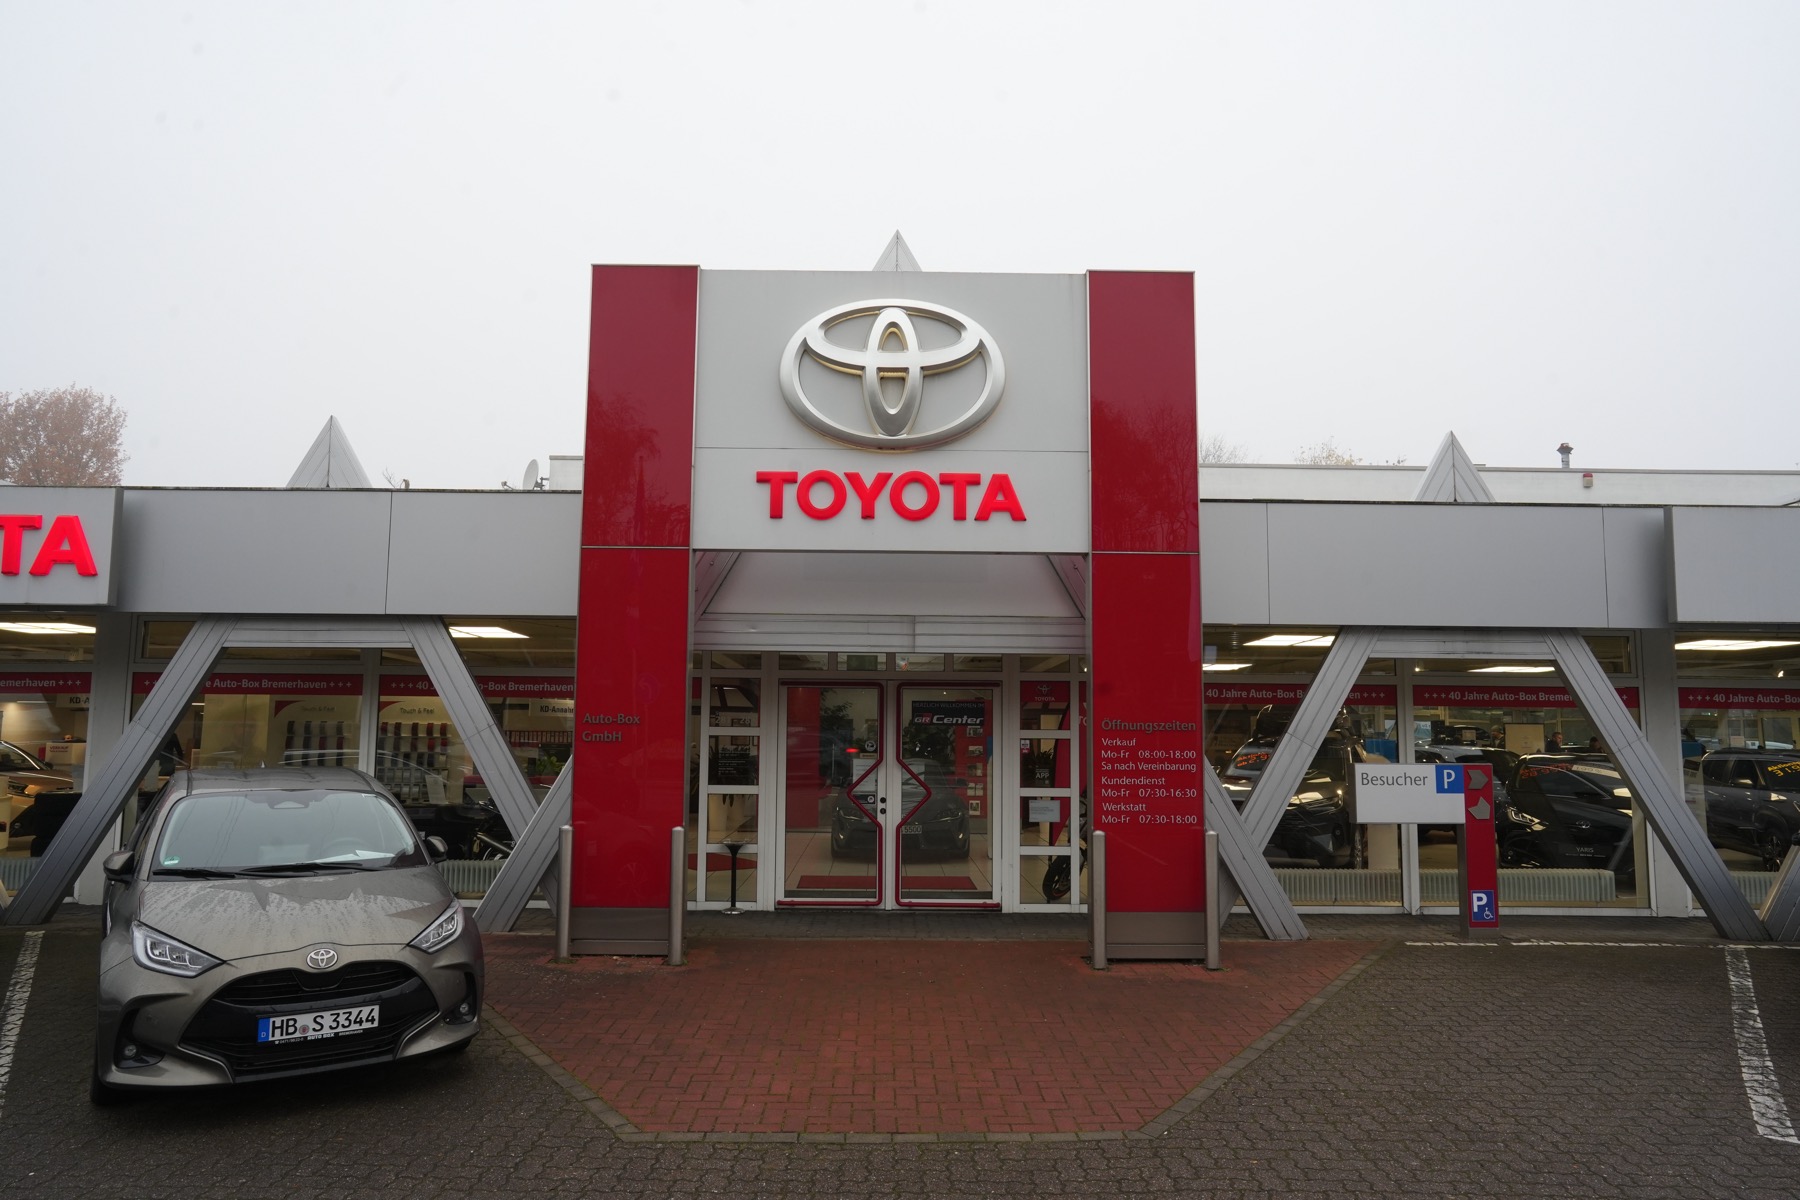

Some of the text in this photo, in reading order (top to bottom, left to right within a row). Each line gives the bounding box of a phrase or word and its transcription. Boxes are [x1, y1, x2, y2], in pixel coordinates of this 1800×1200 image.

[756, 469, 1027, 521] TOYOTA
[0, 678, 56, 687] emerhaven
[213, 679, 260, 688] Auto-Box
[261, 679, 327, 689] Bremerhaven
[416, 681, 428, 690] 40
[478, 682, 574, 691] o-Box Bremerhaven
[1206, 689, 1219, 698] 40
[1220, 689, 1247, 698] Jahre
[1249, 689, 1294, 699] Auto-Box
[1448, 692, 1461, 700] 40
[1463, 691, 1490, 701] Jahre
[1491, 692, 1537, 701] Auto-Box
[1538, 692, 1573, 701] Bremer
[1713, 694, 1726, 702] 40
[1728, 694, 1754, 703] Jahre
[582, 713, 641, 724] Auto-Box
[932, 715, 984, 724] Center
[1101, 717, 1196, 734] Öffnungszeiten
[582, 731, 623, 742] GmbH
[1101, 738, 1136, 746] Verkauf
[1101, 750, 1196, 759] Mo-Fr 08:00-18:00
[1101, 762, 1197, 773] Sa nach Vereinbarung
[1101, 776, 1166, 785] Kundendienst
[1361, 772, 1428, 786] Besucher
[1444, 770, 1456, 789] P
[1101, 789, 1197, 797] Mo-Fr 07:30-16:30
[1102, 803, 1147, 812] Werkstatt
[1101, 815, 1197, 824] Mo-Fr 07:30-18:00
[1472, 892, 1488, 913] P
[271, 1018, 298, 1038] HB
[312, 1015, 325, 1033] S
[329, 1008, 376, 1030] 3344
